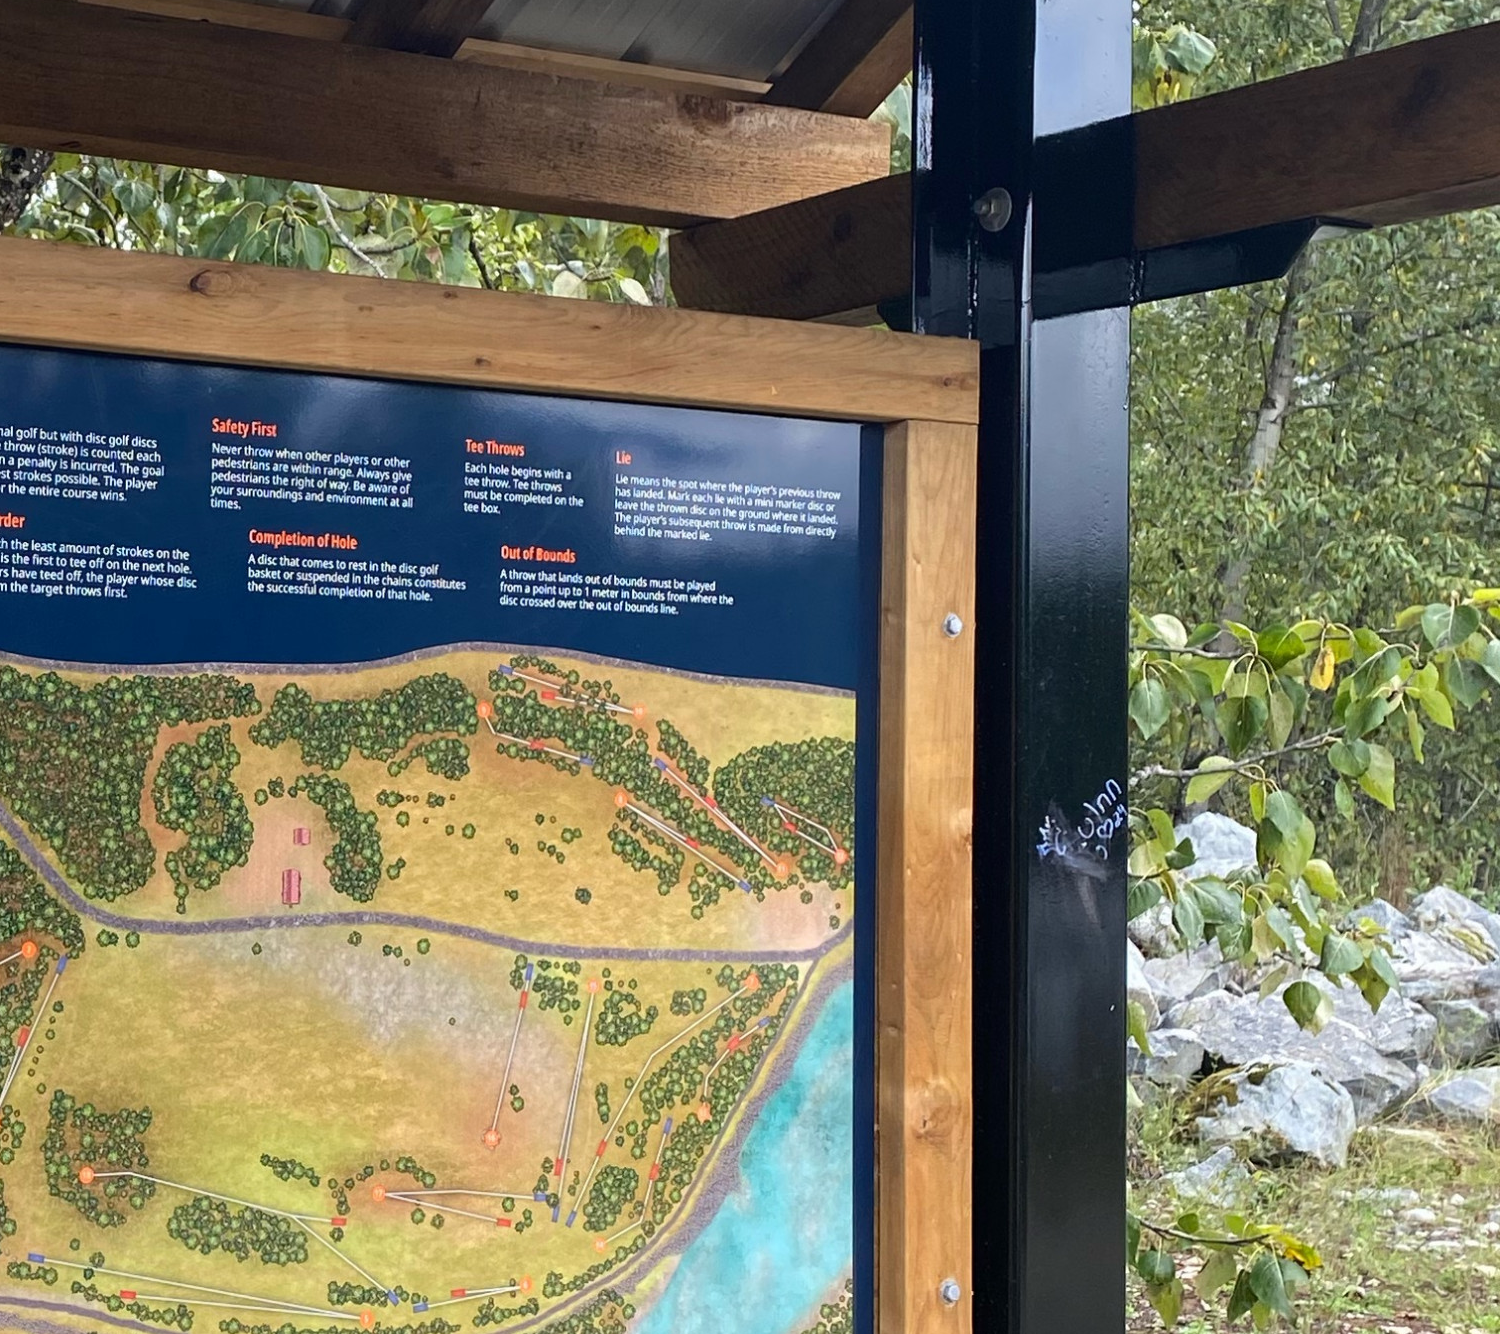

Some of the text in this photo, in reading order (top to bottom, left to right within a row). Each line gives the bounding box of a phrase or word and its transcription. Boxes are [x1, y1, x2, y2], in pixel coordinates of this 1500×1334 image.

[212, 418, 277, 439] Safety First
[465, 439, 524, 456] Tee Throws
[616, 451, 631, 465] Lie
[464, 462, 571, 480] Each hole begins with a
[464, 476, 562, 492] tee throw. Tee throws
[464, 489, 584, 507] must be completed on the
[463, 501, 500, 514] tee box.
[248, 529, 357, 549] Completion of Hole
[500, 545, 575, 563] Out of Bounds
[247, 580, 432, 601] the successful completion of that hole.
